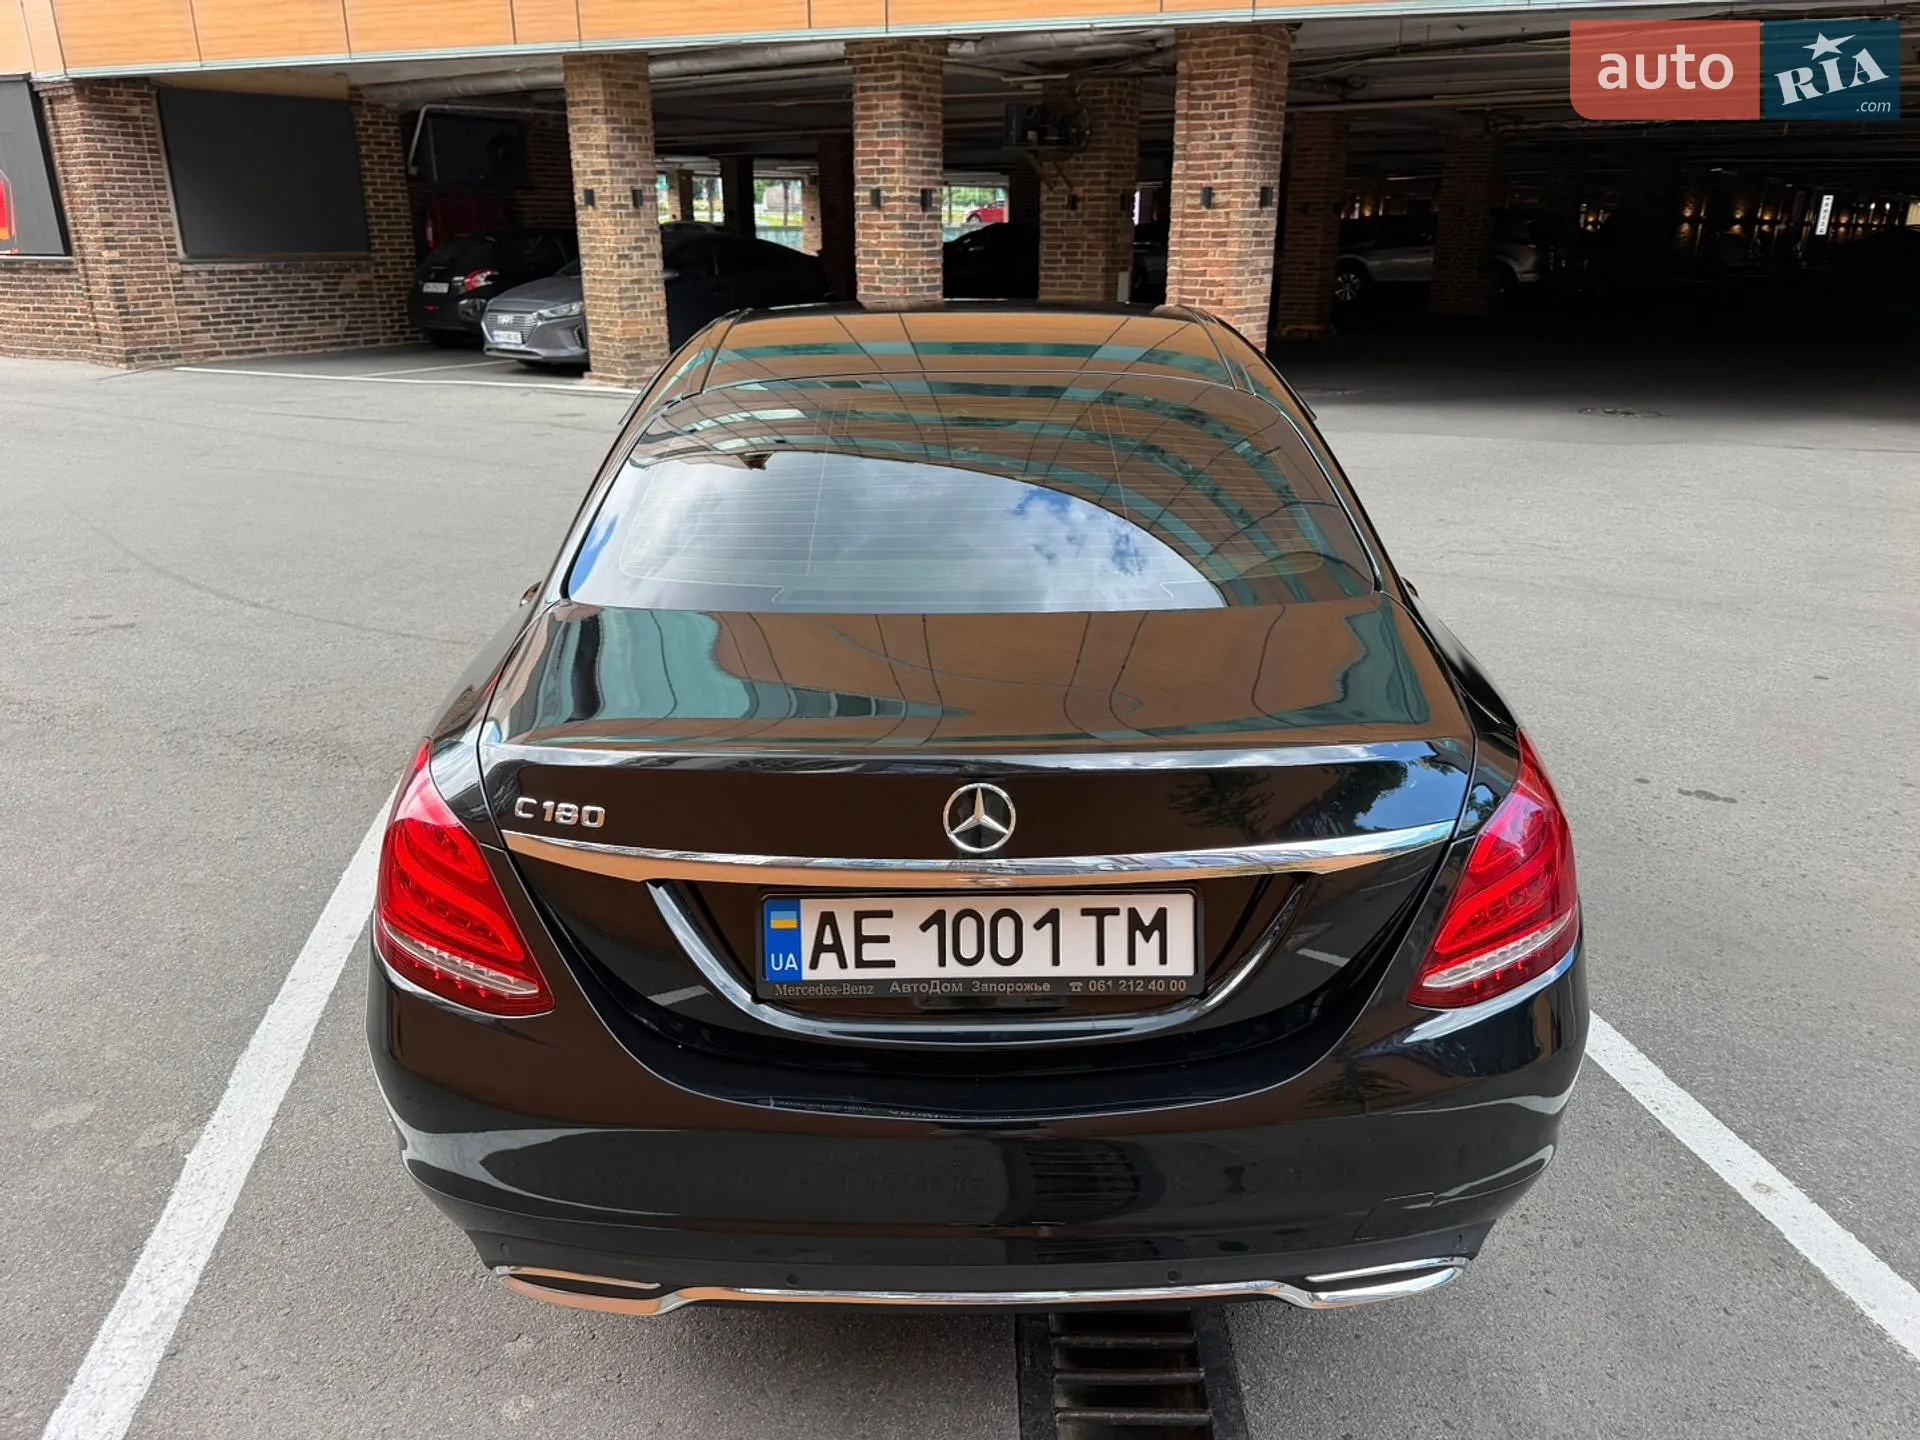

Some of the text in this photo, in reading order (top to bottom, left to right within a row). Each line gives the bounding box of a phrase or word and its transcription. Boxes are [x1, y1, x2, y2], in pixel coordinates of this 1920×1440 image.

[809, 907, 1168, 970] AE 1001 TM
[771, 953, 798, 971] UA
[775, 979, 1188, 997] Mercedes-Benz АвтоДом Запорожье 061 212 40 00
